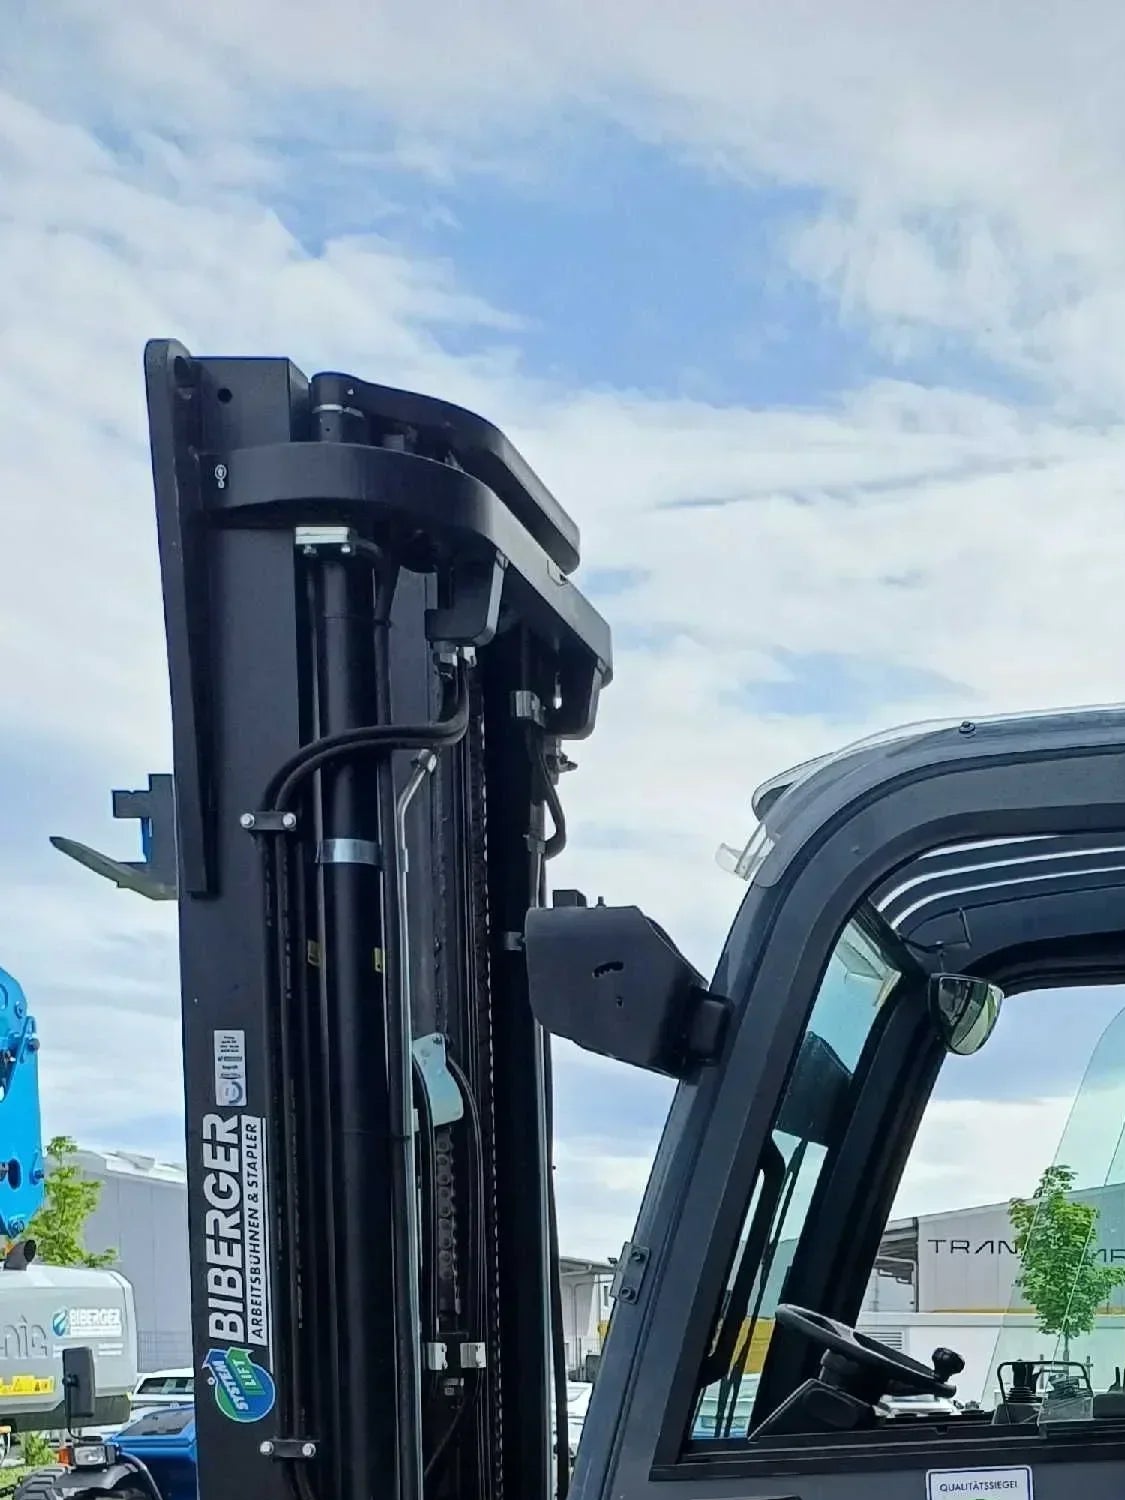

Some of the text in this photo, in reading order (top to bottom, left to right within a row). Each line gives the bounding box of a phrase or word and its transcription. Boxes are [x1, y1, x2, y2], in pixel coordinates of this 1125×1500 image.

[202, 1113, 245, 1343] BIBERGER
[246, 1123, 263, 1339] ARBEITSBÜHNEN & STAPLER
[211, 1360, 248, 1411] SYSTEM
[232, 1359, 257, 1386] LIFT
